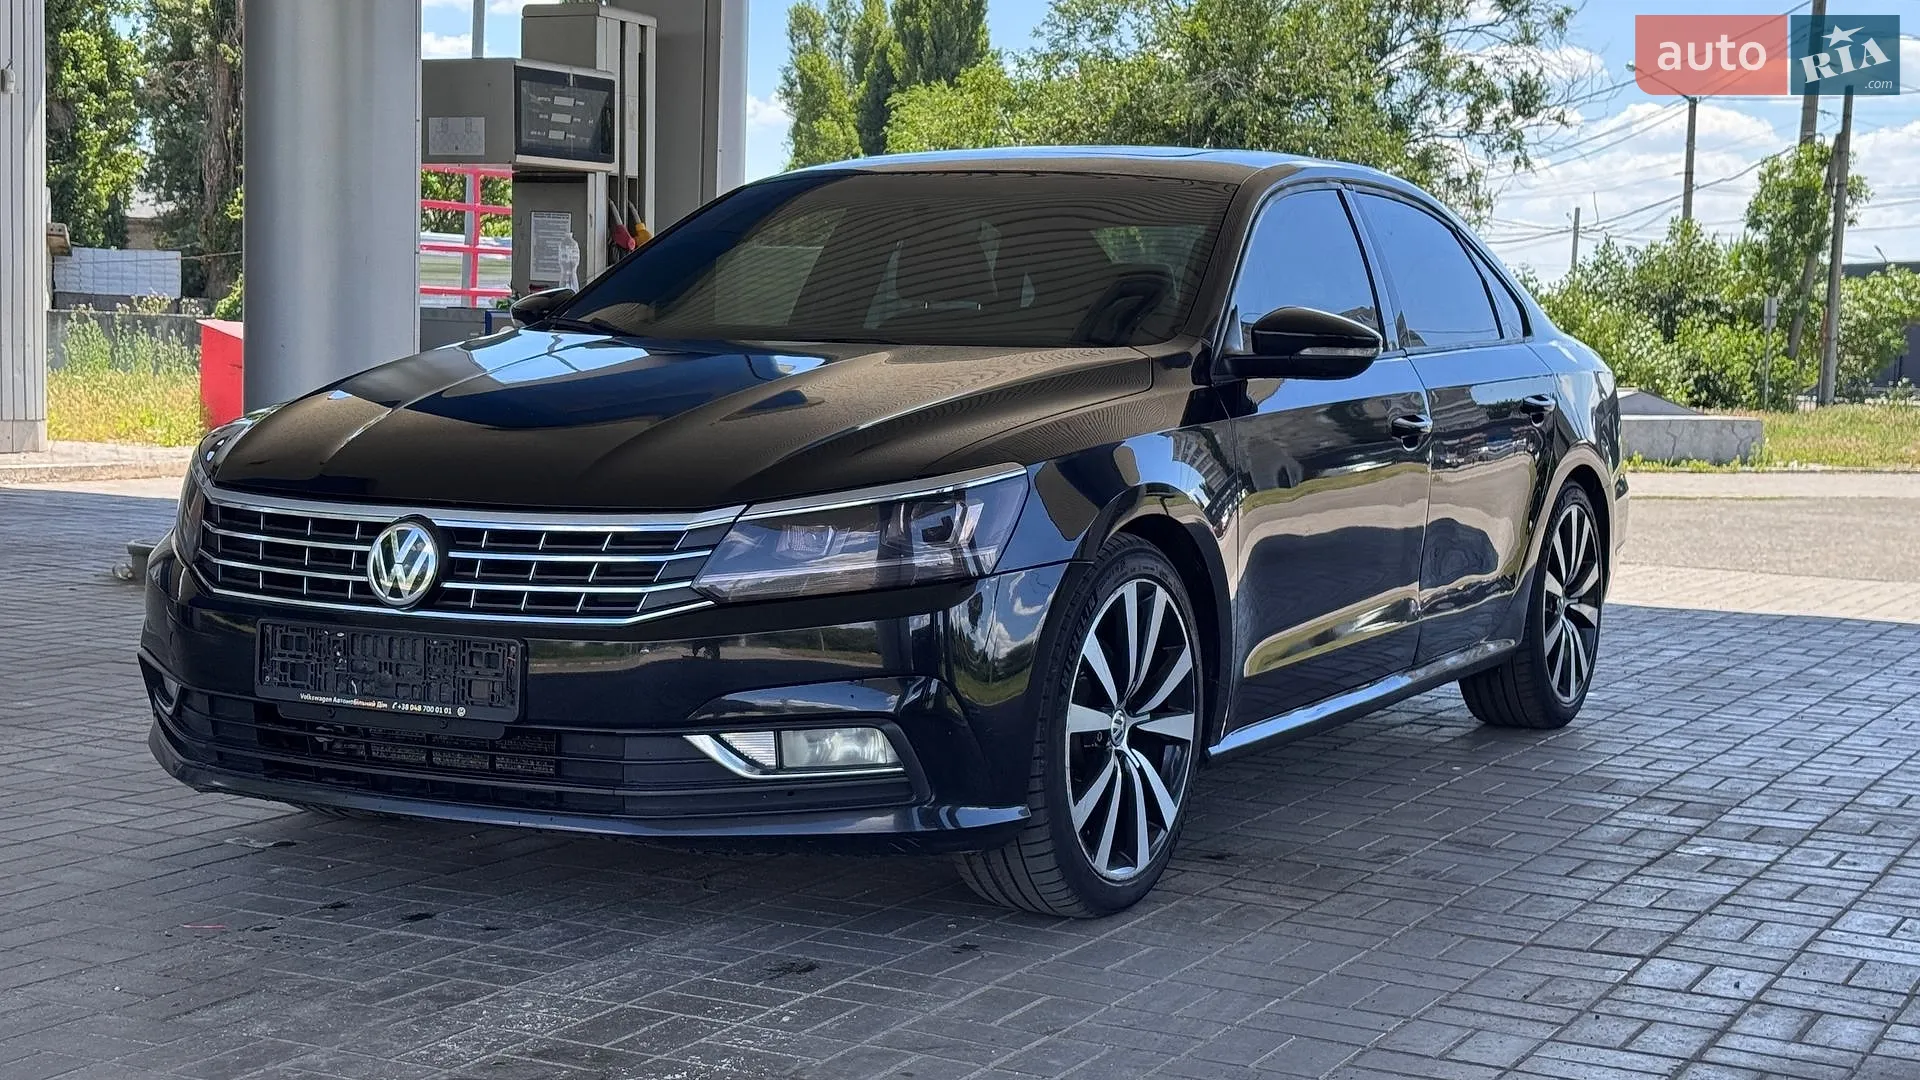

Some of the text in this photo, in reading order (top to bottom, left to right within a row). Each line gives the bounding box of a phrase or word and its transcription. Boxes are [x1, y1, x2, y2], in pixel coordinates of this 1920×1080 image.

[300, 693, 332, 703] Volkswagen
[410, 704, 422, 712] 048
[423, 705, 434, 713] 700
[435, 706, 443, 714] 01
[444, 707, 452, 715] 01
